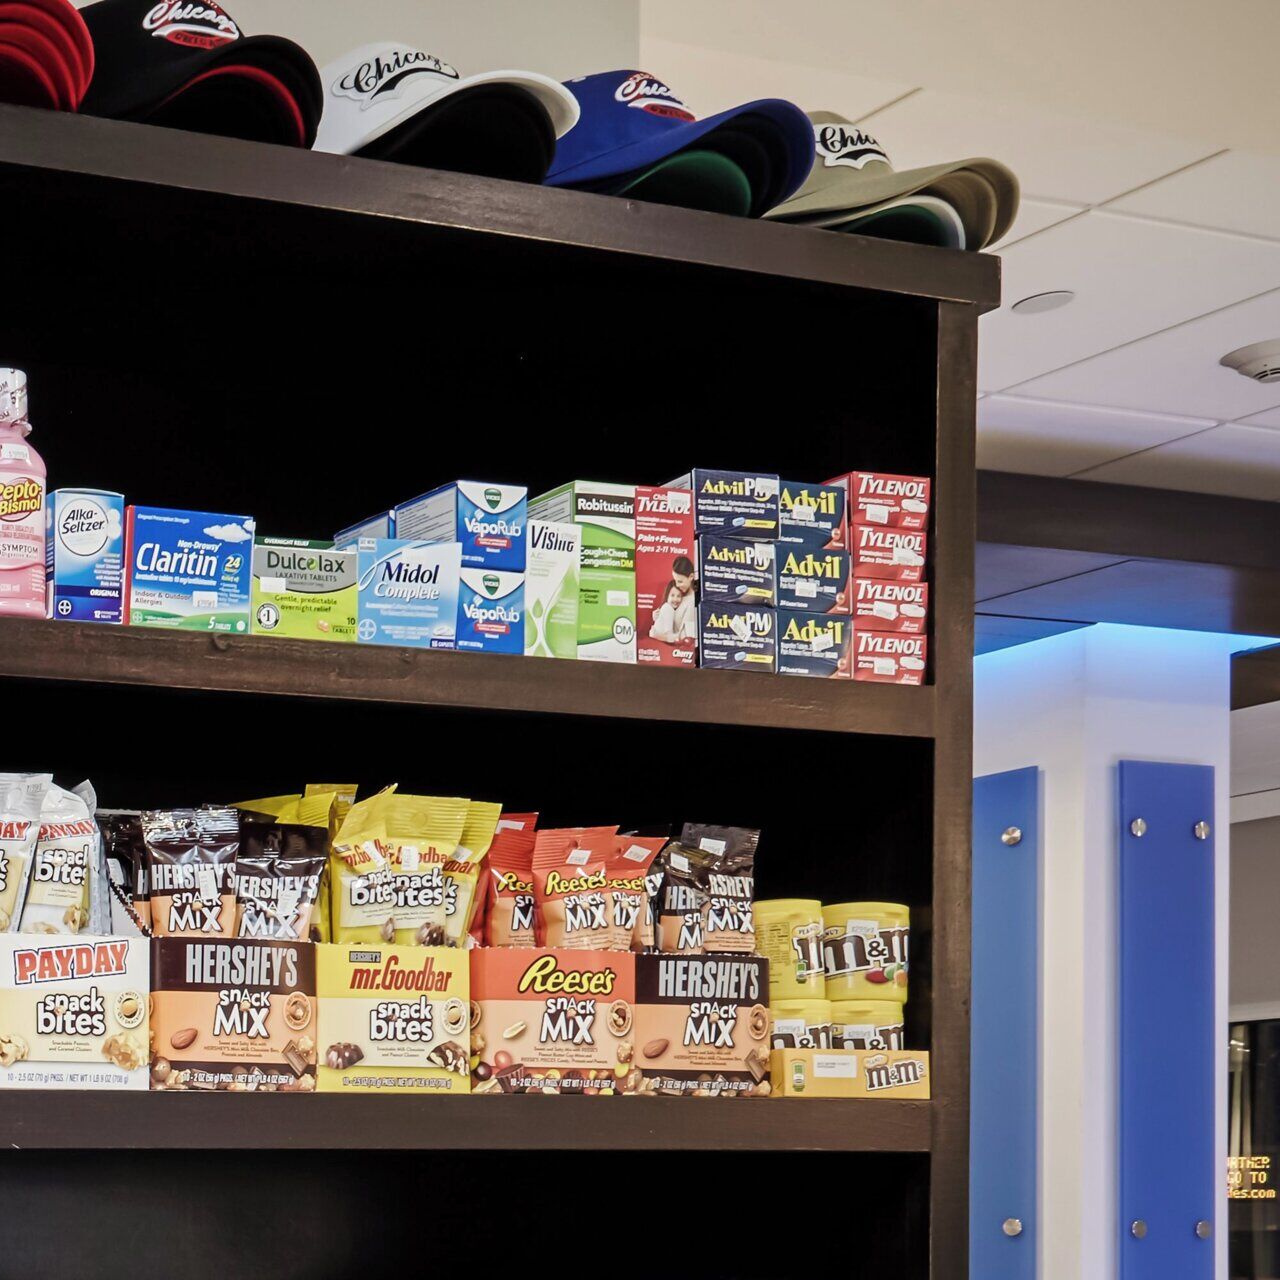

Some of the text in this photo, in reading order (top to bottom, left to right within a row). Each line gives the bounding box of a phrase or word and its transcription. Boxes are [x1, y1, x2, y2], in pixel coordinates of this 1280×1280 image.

[701, 479, 744, 495] Advil
[858, 474, 926, 499] TYLENOL
[578, 498, 633, 514] Robitussin
[62, 519, 104, 534] Seltzer
[465, 515, 521, 537] VapoRub
[136, 542, 218, 578] Claritin
[267, 549, 345, 574] Dulcolax
[783, 551, 842, 579] Advil
[381, 560, 439, 586] Midol
[90, 589, 119, 597] ORIGINAL
[374, 582, 440, 601] Complete
[856, 579, 924, 602] TYLENOL
[616, 624, 633, 635] DM
[15, 941, 128, 984] PAYDAY
[186, 944, 298, 988] HERSHEY'S
[519, 956, 616, 995] Reese's
[658, 960, 759, 1000] HERSHEY'S
[44, 988, 103, 1013] snack
[376, 996, 432, 1024] snack
[37, 1005, 105, 1036] bites
[1250, 1171, 1267, 1183] TO
